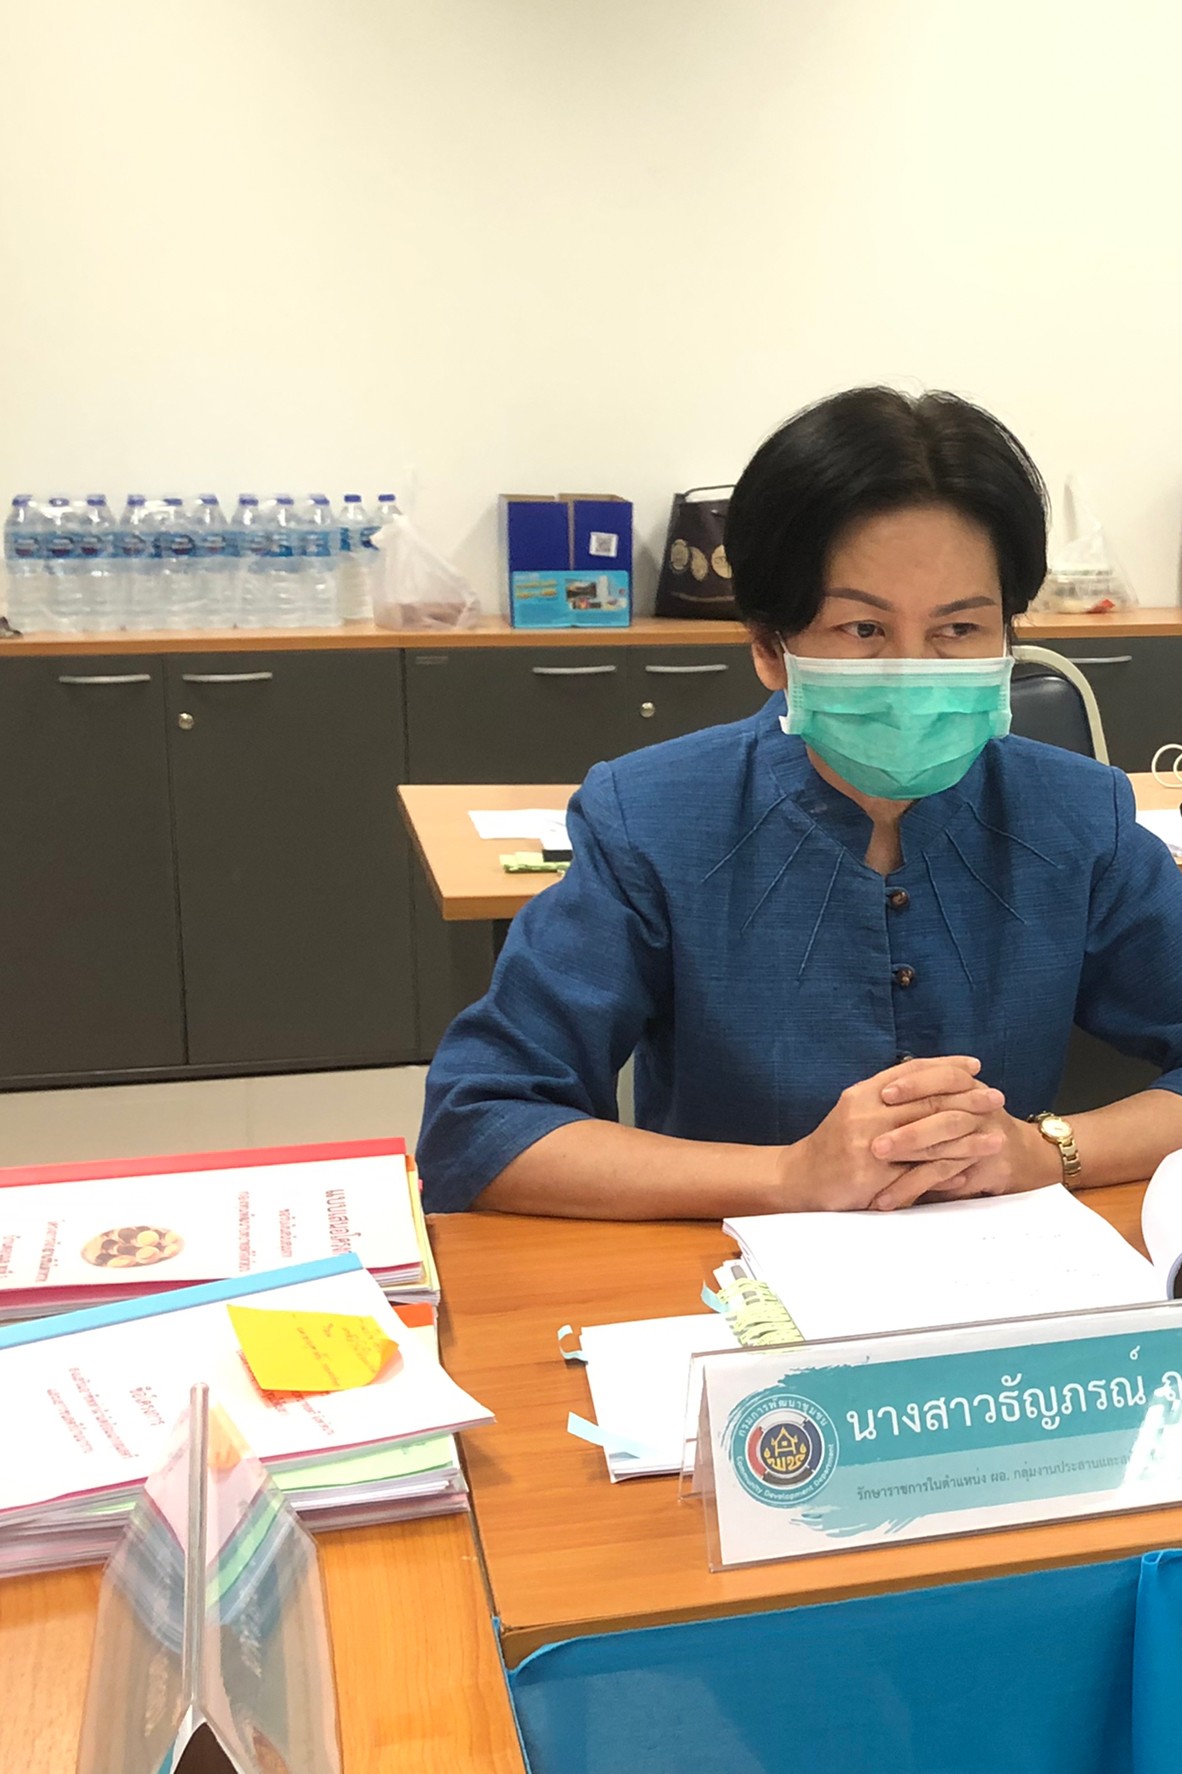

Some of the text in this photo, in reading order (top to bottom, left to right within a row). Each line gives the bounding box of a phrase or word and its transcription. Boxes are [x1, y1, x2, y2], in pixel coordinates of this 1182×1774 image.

[738, 1398, 829, 1438] กรมการพัฒนาชุมชน
[847, 1345, 1147, 1442] นางสาวธัญภรณ์
[736, 1443, 835, 1501] Community Development Department
[857, 1467, 987, 1500] รักษาราชการในตำแหน่ง
[990, 1470, 1010, 1483] ผอ.
